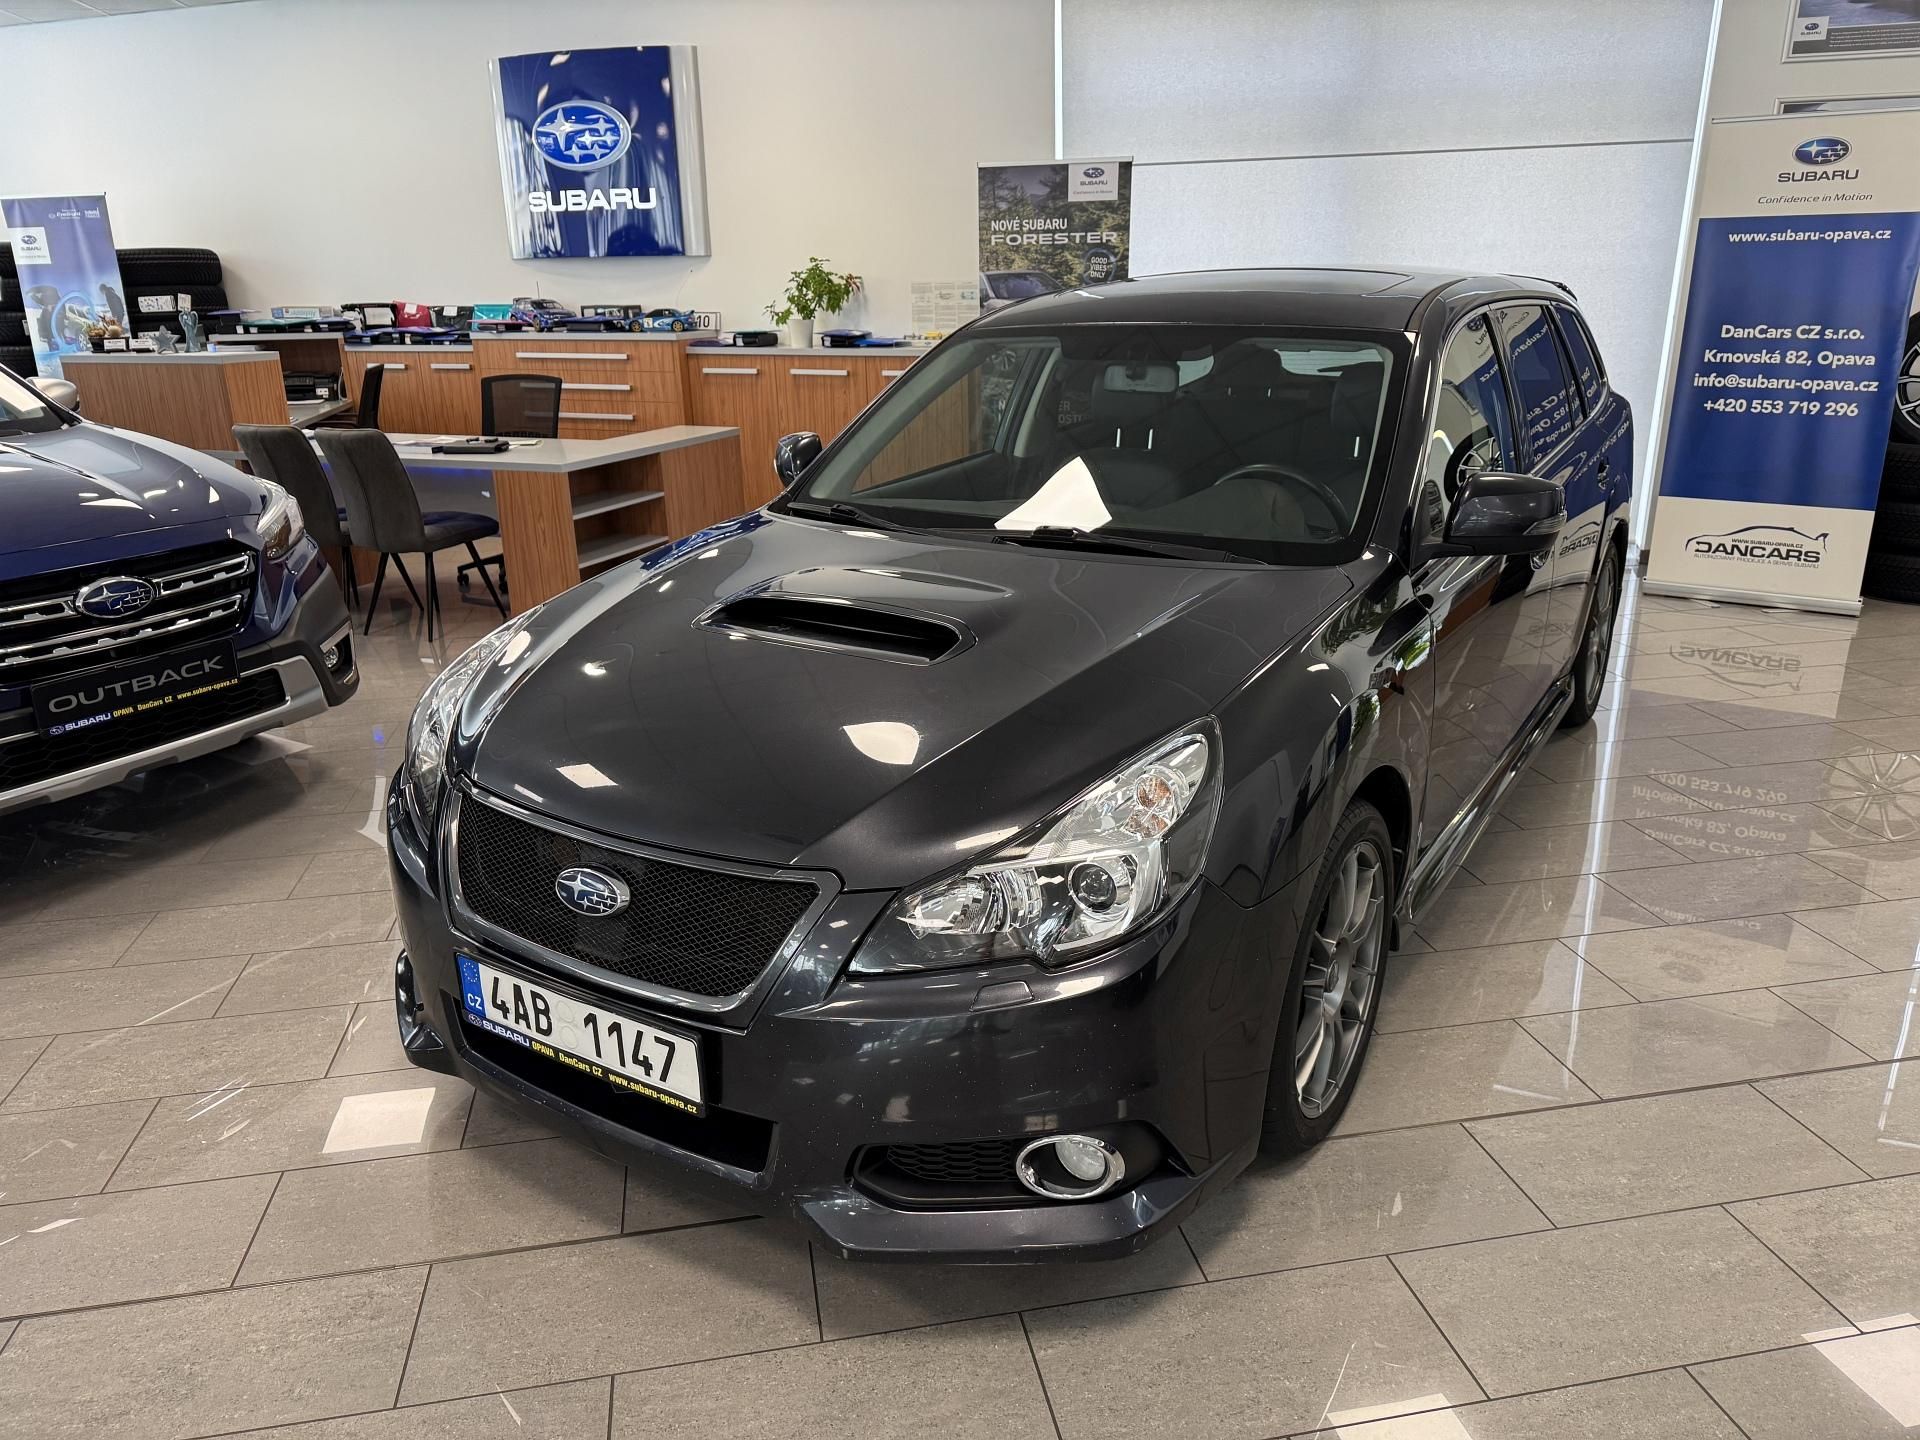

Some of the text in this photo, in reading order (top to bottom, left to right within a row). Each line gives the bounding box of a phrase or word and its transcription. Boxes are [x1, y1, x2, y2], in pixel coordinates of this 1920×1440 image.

[1777, 169, 1860, 183] SUBARU
[528, 187, 657, 212] SUBARU
[1758, 192, 1873, 205] Confidence in Motion
[991, 216, 1068, 232] NOVÉ SUBARU
[990, 231, 1118, 246] FORESTER
[1728, 229, 1892, 243] www.subaru-opava.cz
[1090, 256, 1108, 264] GOOD
[1090, 263, 1107, 271] VIBES
[1720, 324, 1865, 340] DanCars CZ s.r.o.
[1704, 349, 1876, 369] Krnovská 82, Opava
[1693, 373, 1880, 394] info@subaru-opava.cz
[1703, 398, 1859, 417] +420 553 719 296
[1694, 541, 1821, 563] DANCARS
[1731, 538, 1804, 549] WWW.SUBARU-OPAVA.CZ
[48, 655, 224, 713] OUTBACK
[64, 677, 239, 732] SUBARU OPAVA DanCars CZ www.subaru-opava.cz
[467, 992, 483, 1011] CZ
[491, 976, 676, 1083] 4AB 1147
[482, 1020, 698, 1114] SUBARU OPAVA DanCars CZ www.subaru-opava.cz
